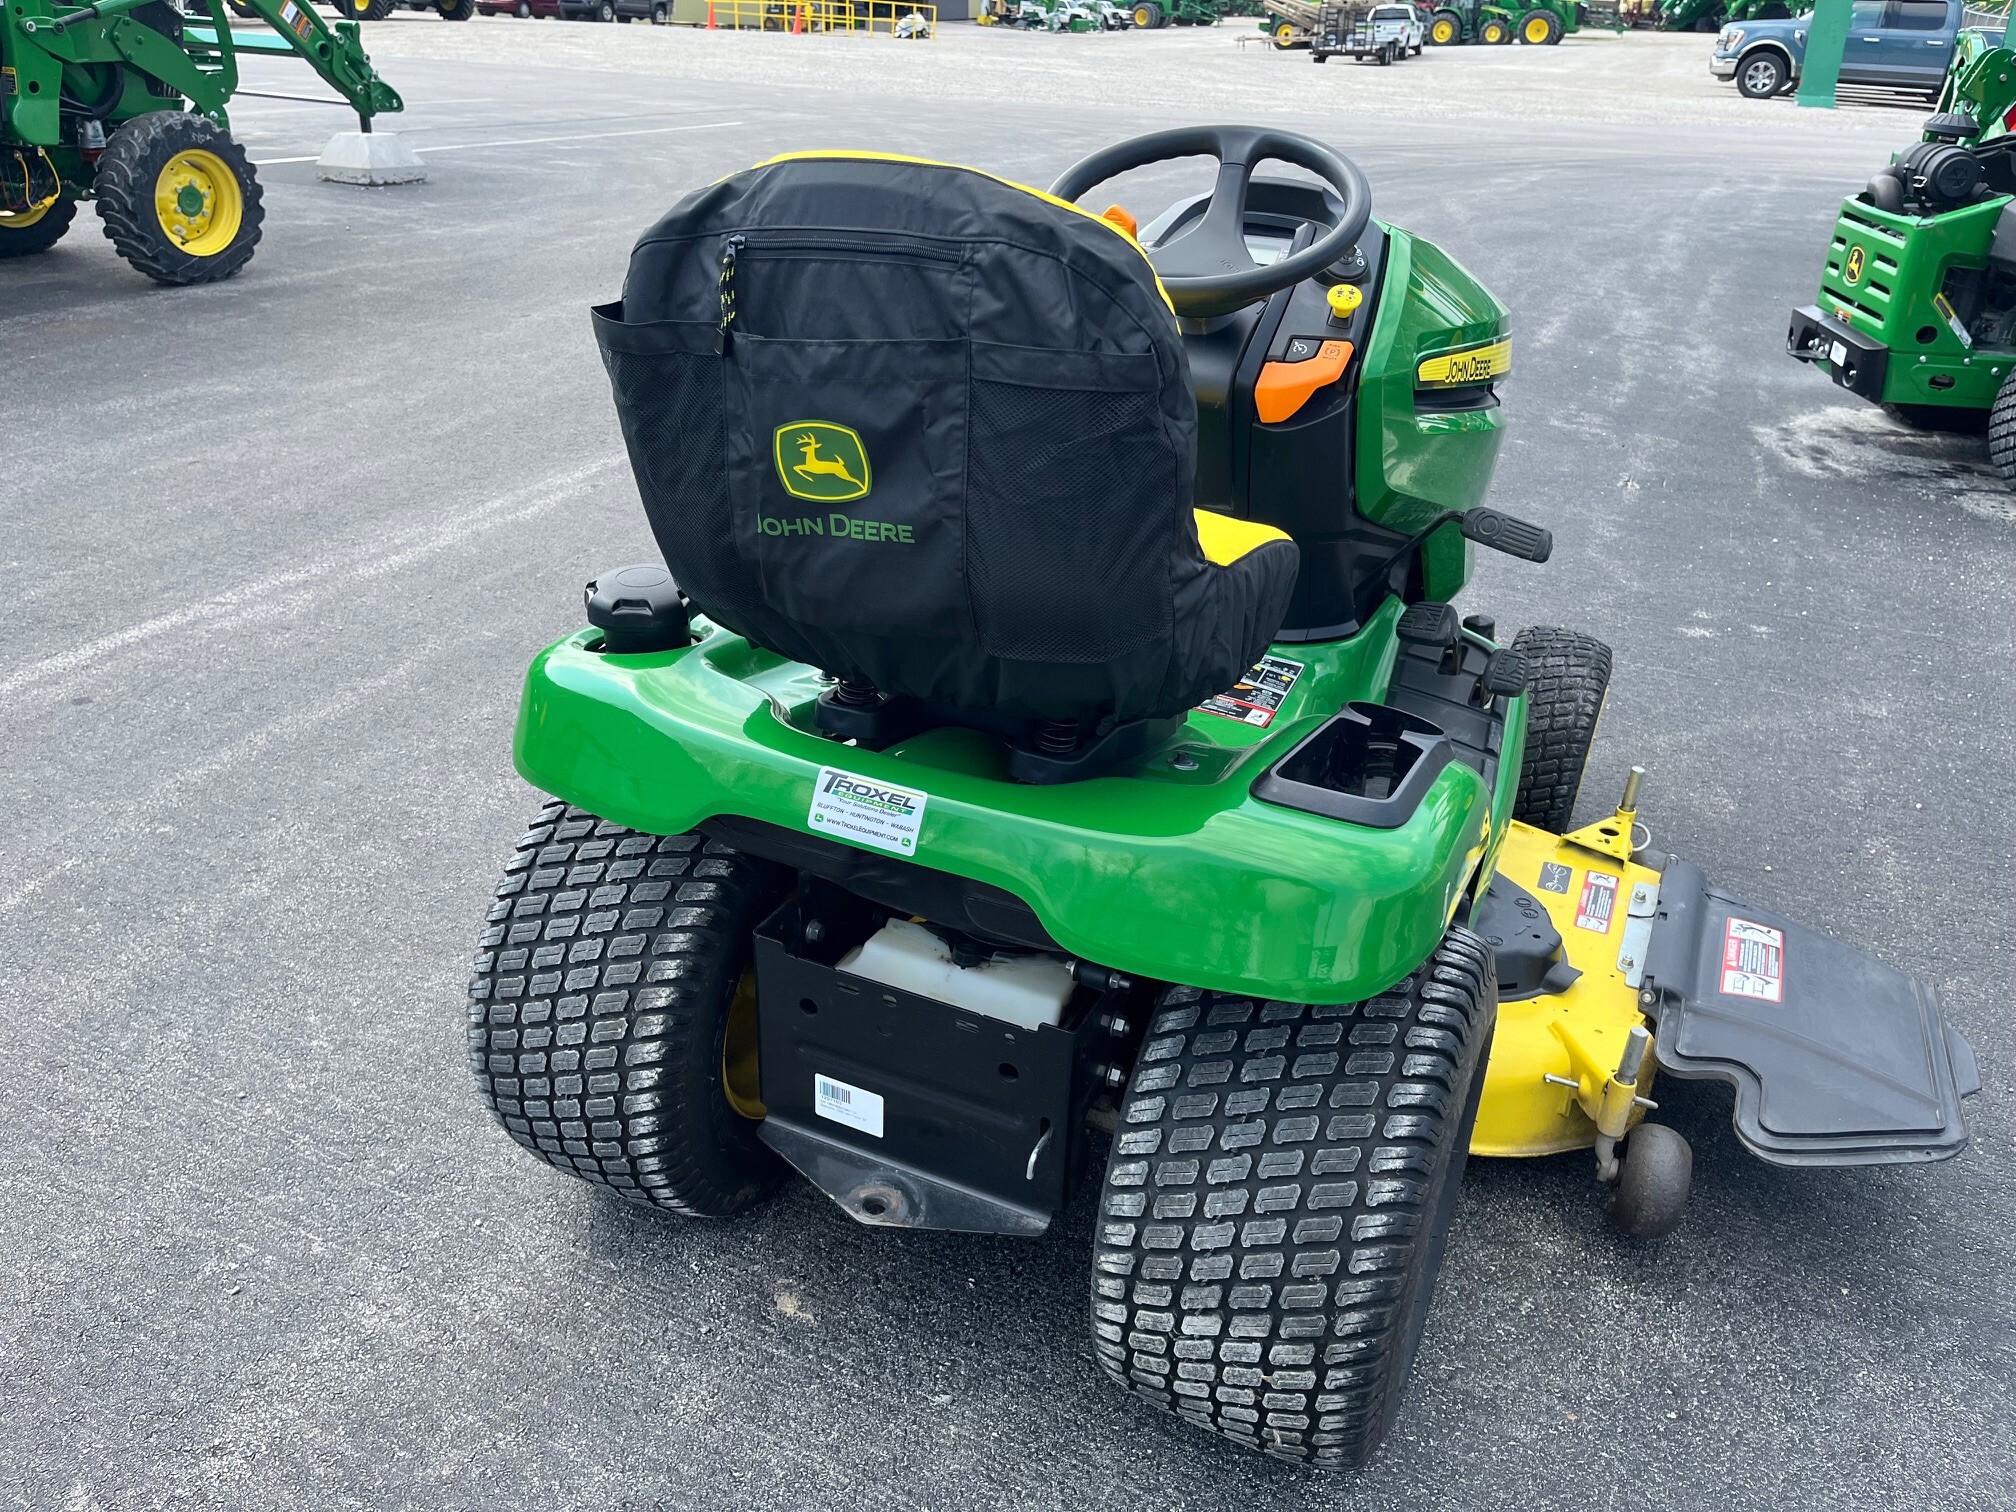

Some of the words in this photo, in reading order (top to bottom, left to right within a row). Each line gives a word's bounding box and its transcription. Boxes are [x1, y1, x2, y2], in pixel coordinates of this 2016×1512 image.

[1445, 358, 1470, 380] JOHN
[1470, 356, 1491, 377] DEERE
[829, 513, 915, 544] DEERE
[823, 770, 916, 810] TROXEL
[838, 791, 908, 813] EQUIPMENT
[817, 801, 846, 814] BLUFFTON
[849, 811, 885, 825] HUNTINGTON
[890, 822, 915, 833] WABASH
